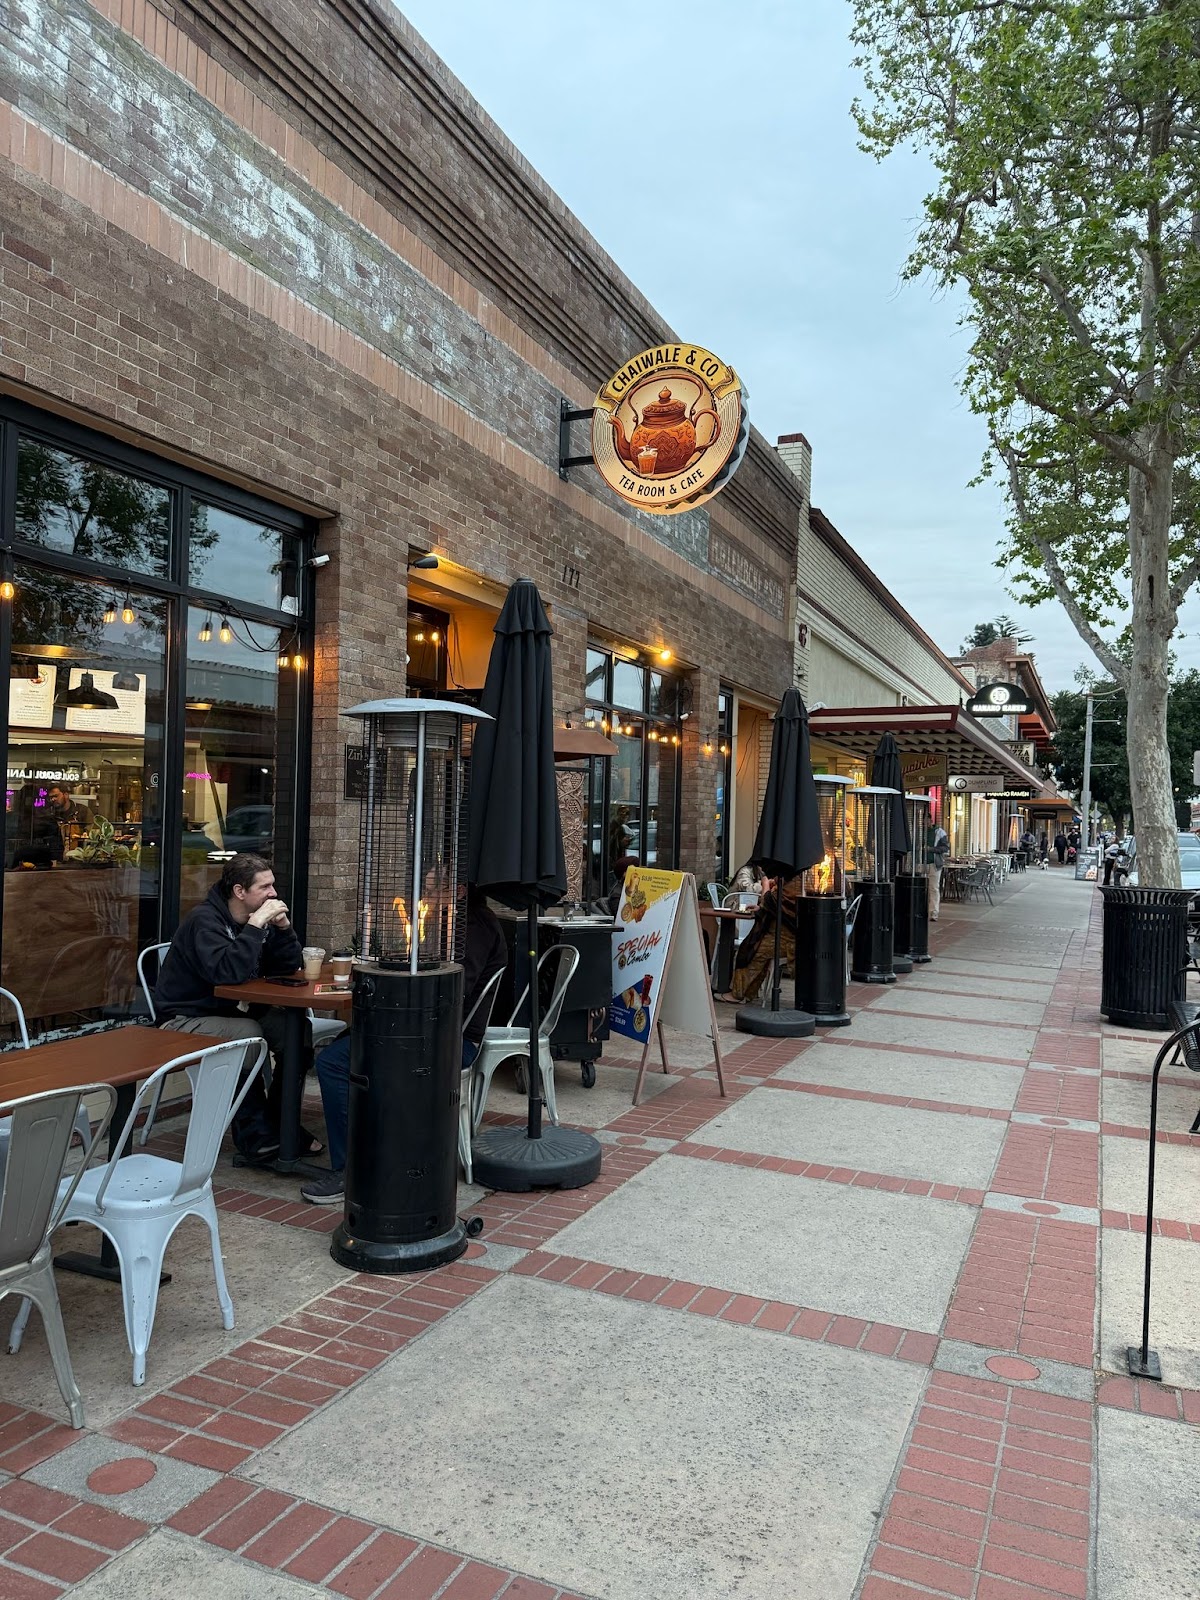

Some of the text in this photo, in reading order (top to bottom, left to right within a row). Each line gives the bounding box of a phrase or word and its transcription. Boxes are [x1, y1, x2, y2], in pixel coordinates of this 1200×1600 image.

[612, 347, 719, 393] CHAIWALE & CO.
[619, 468, 704, 497] TEA ROOM & CAFE
[615, 930, 662, 959] SPECIAL
[626, 949, 652, 966] Combo
